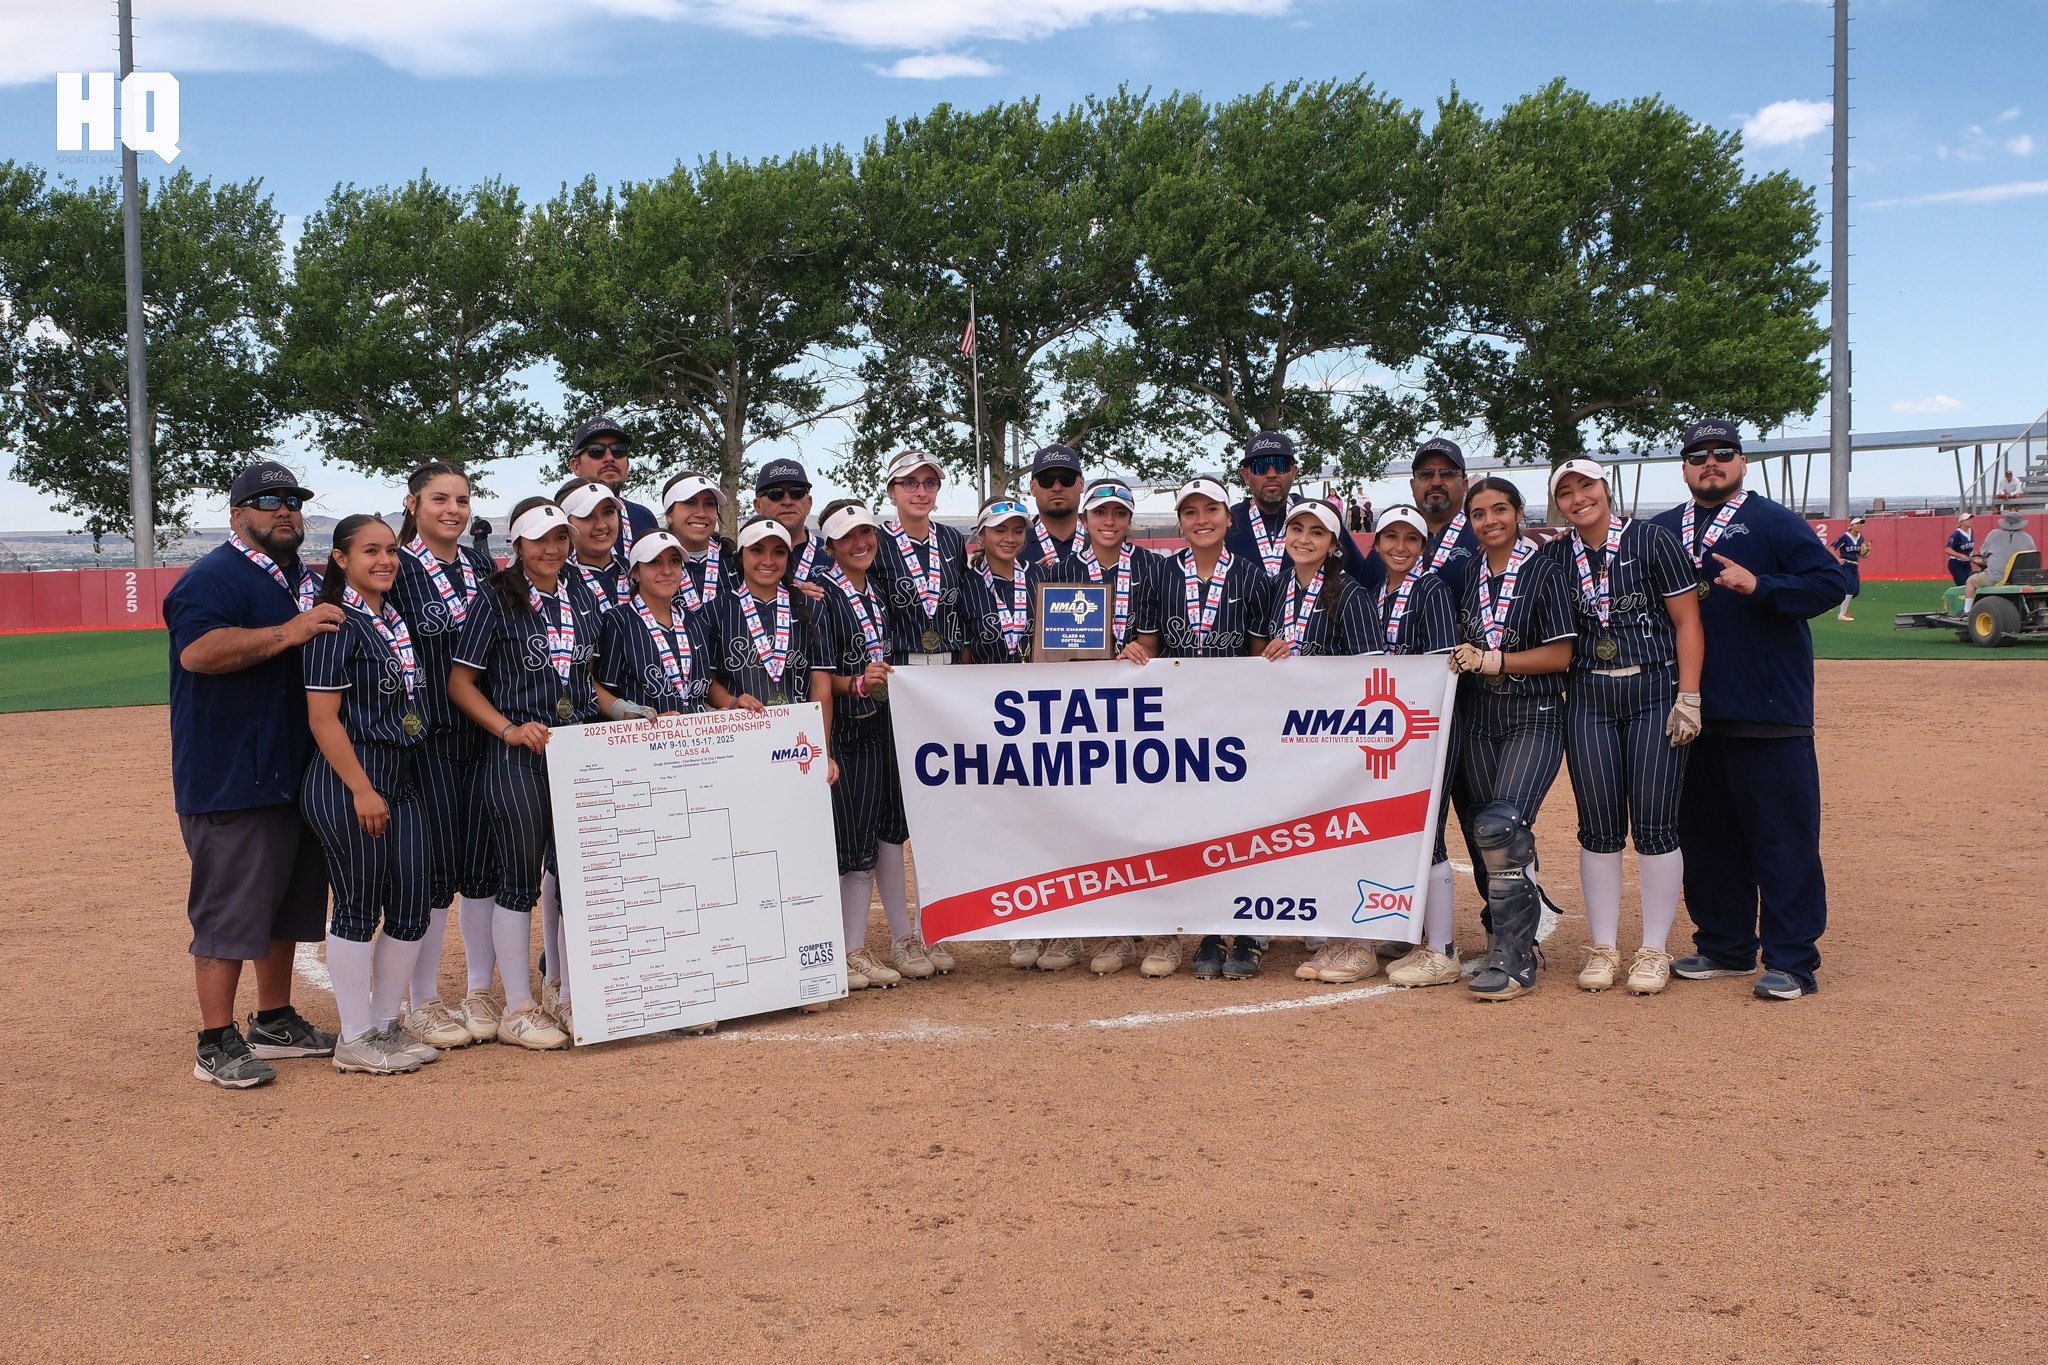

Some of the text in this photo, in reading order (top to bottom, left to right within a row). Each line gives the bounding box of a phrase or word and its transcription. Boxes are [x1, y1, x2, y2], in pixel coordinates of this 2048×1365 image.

[125, 572, 138, 612] 225
[1050, 602, 1084, 611] NMAA
[584, 708, 790, 737] 2025 NEW MEXICO ACTIVITIES ASSOCIATION
[993, 687, 1165, 737] STATE
[1282, 709, 1394, 735] NMAA
[608, 720, 771, 746] STATE SOFTBALL CHAMPIONSHIPS
[650, 734, 735, 751] MAY 9-10, 15-17, 2025
[675, 748, 699, 757] CLASS
[771, 747, 808, 761] NMAA
[914, 736, 1248, 787] CHAMPIONS
[990, 812, 1370, 917] SOFTBALL CLASS 4A
[1232, 896, 1318, 922] 2025
[799, 941, 833, 953] COMPETE
[800, 949, 834, 966] CLASS
